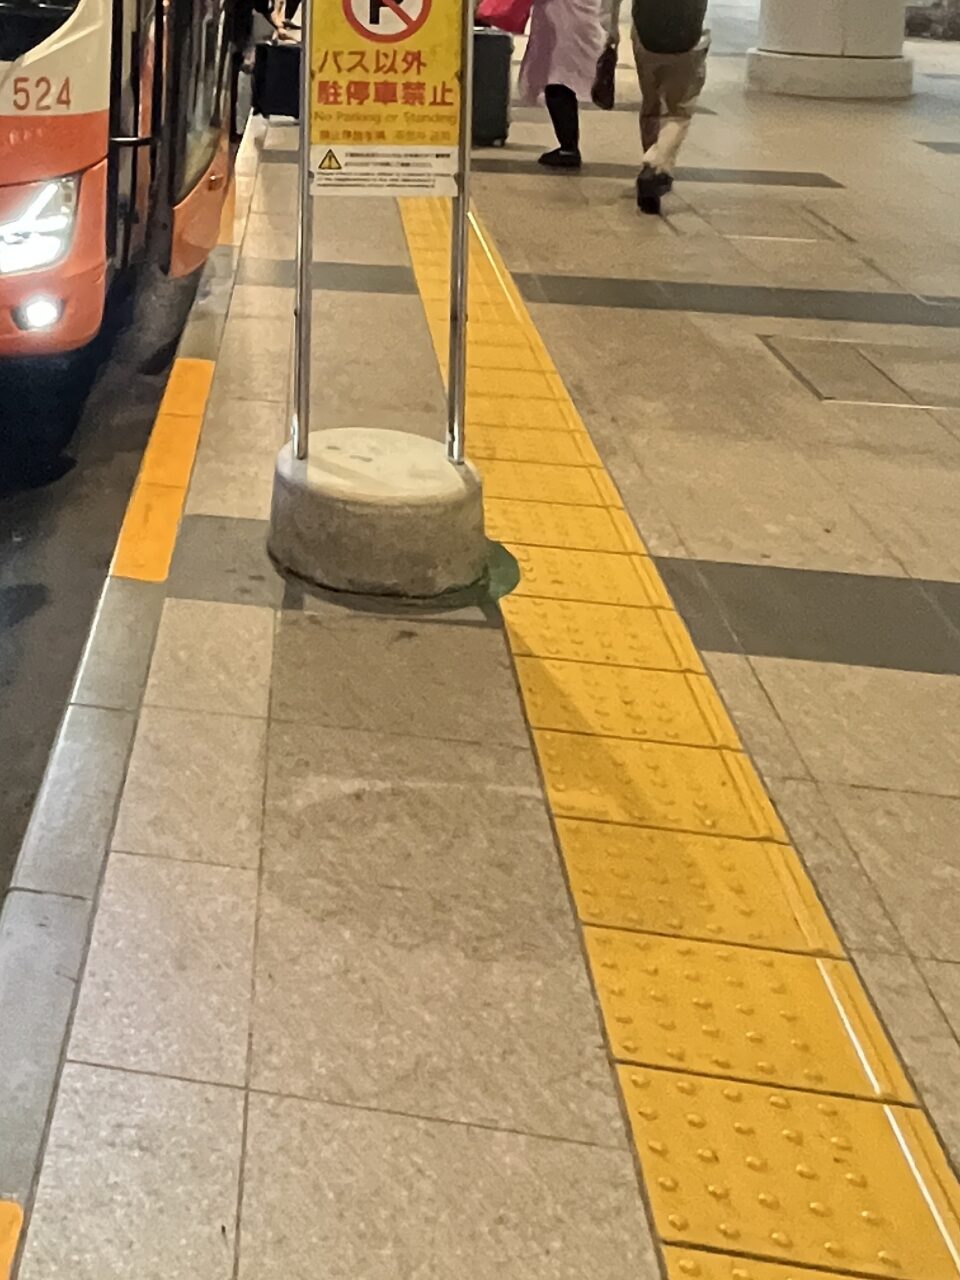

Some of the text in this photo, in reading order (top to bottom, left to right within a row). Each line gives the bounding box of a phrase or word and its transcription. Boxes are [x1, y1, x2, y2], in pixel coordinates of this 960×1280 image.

[318, 49, 427, 75] バス以外
[13, 76, 71, 110] 524
[317, 80, 454, 106] 駐停車禁止
[314, 111, 457, 125] No Parking or Standing
